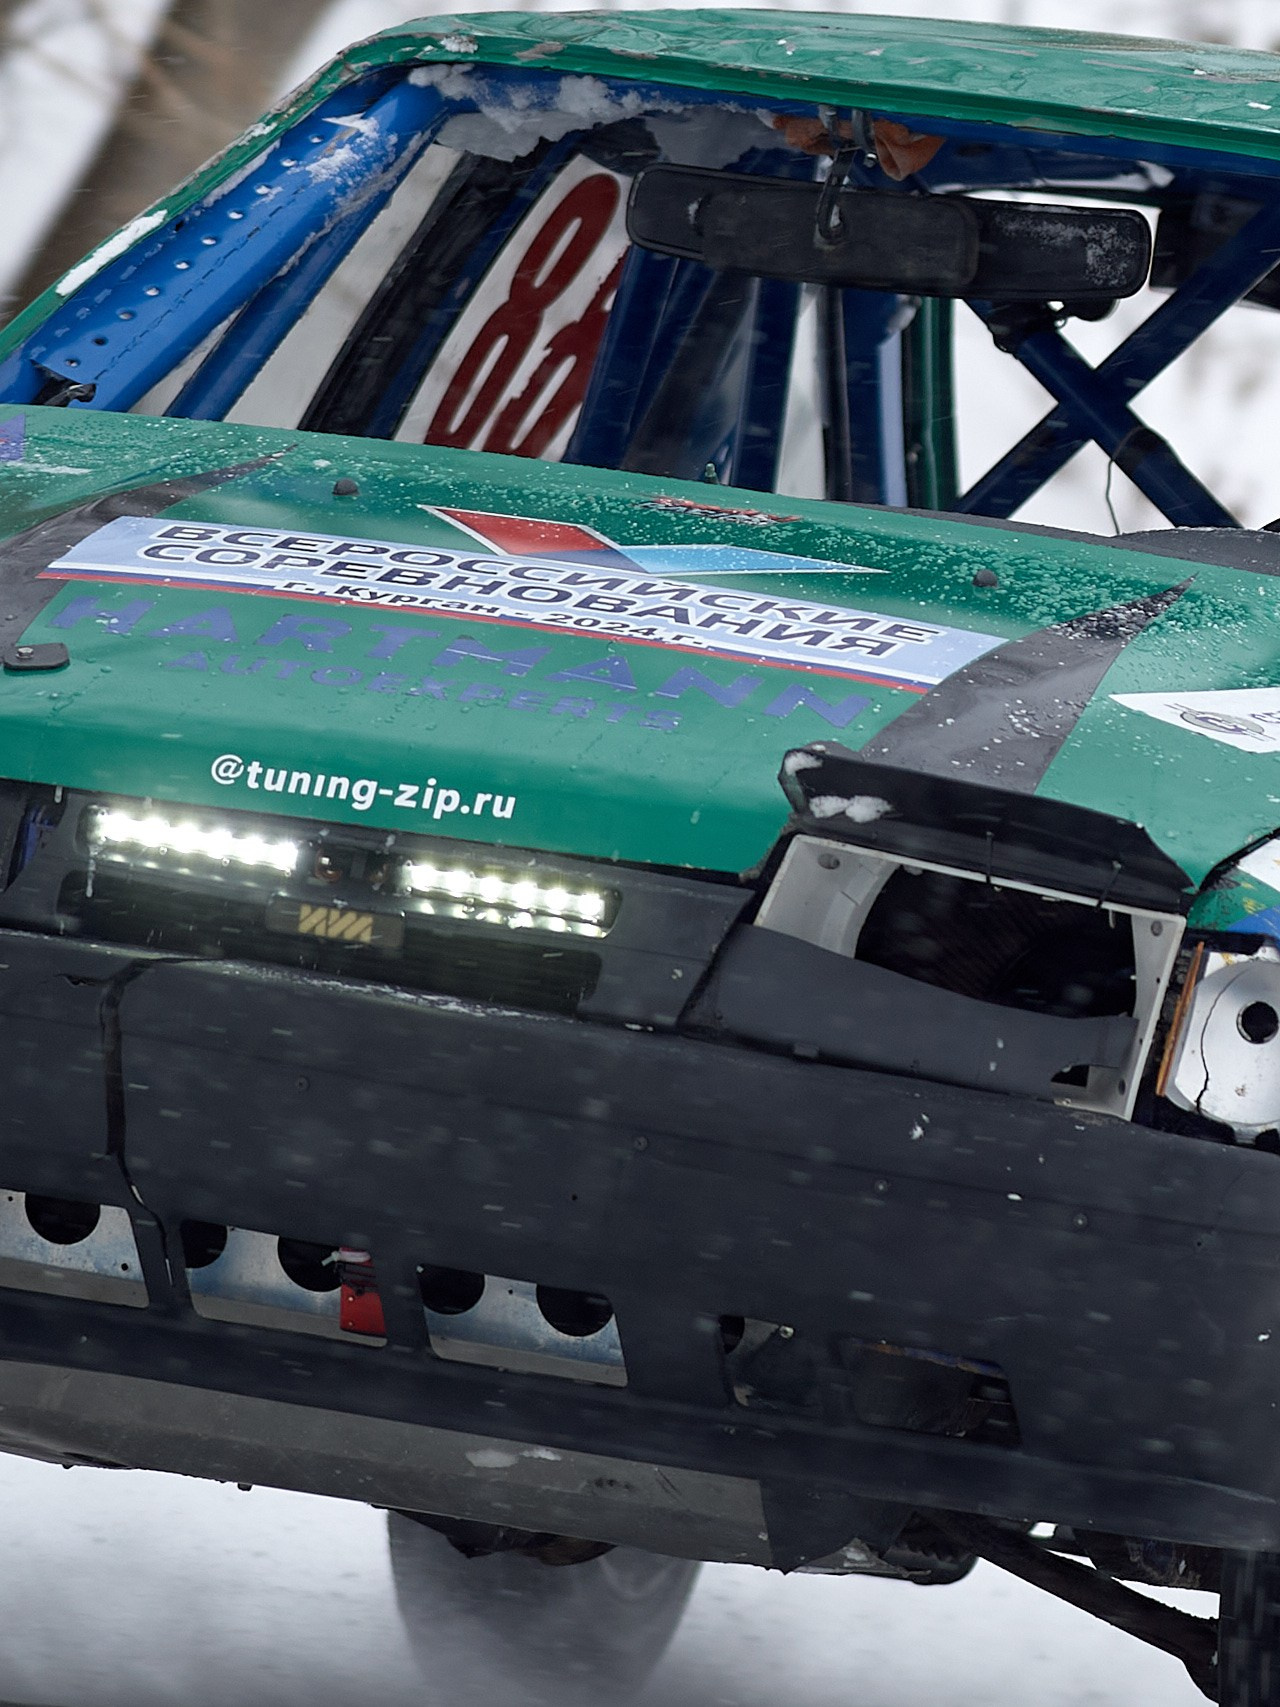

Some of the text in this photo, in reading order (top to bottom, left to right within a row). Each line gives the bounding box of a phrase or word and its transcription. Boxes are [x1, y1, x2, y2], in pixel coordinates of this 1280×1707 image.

[143, 543, 899, 658] СОРЕВНОВАНИЯ
[155, 525, 940, 644] ВСЕРОССИЙСКИЕ
[334, 585, 500, 614] Курган
[546, 613, 659, 637] 2024
[50, 596, 874, 729] HARTMANN
[165, 651, 683, 731] AUTOEXPERTS
[211, 754, 516, 820] @tuning-zip.ru
